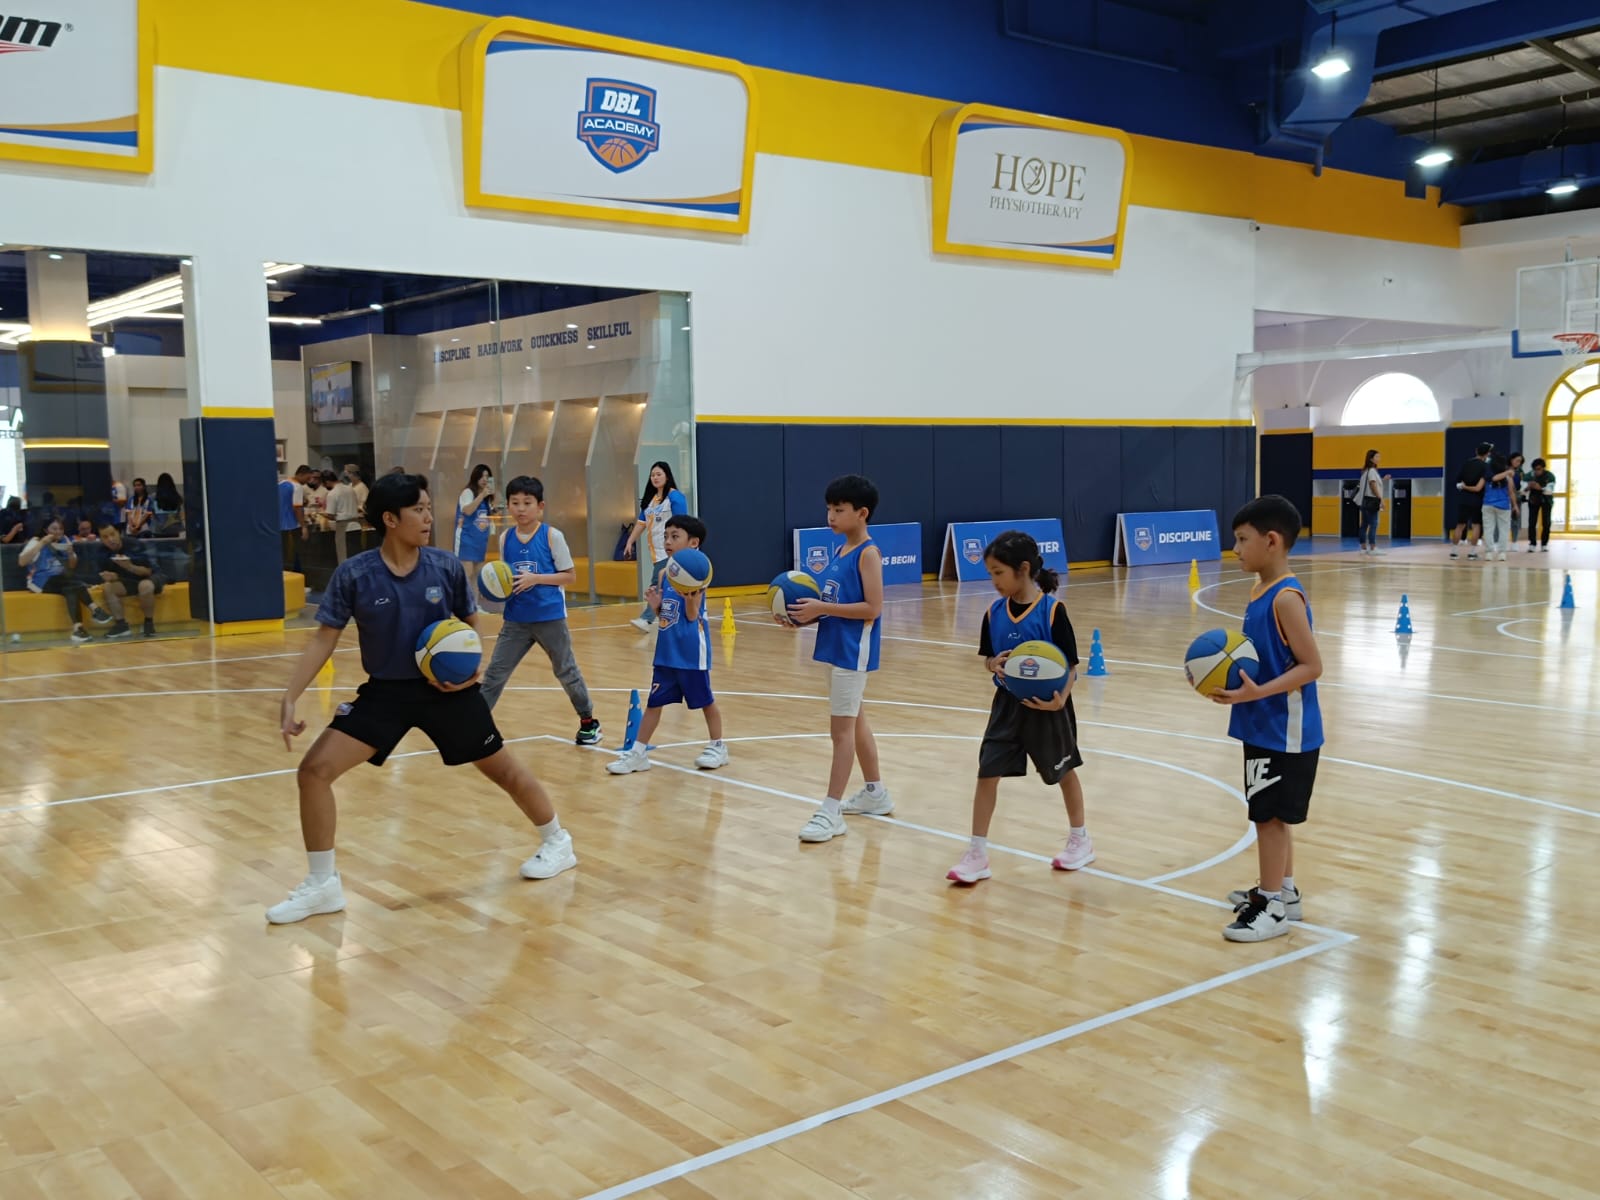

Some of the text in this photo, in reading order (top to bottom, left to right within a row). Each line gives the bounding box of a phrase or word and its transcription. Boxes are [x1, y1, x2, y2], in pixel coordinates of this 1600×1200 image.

[600, 89, 641, 116] DBL
[584, 118, 655, 138] ACADEMY
[992, 152, 1087, 201] HOPE
[989, 195, 1082, 220] PHYSIOTHERAPY
[500, 339, 523, 354] WORK
[530, 329, 578, 349] QUICKNESS
[586, 321, 632, 341] SKILLFUL
[1158, 530, 1213, 544] DISCIPLINE
[890, 554, 917, 565] BEGIN
